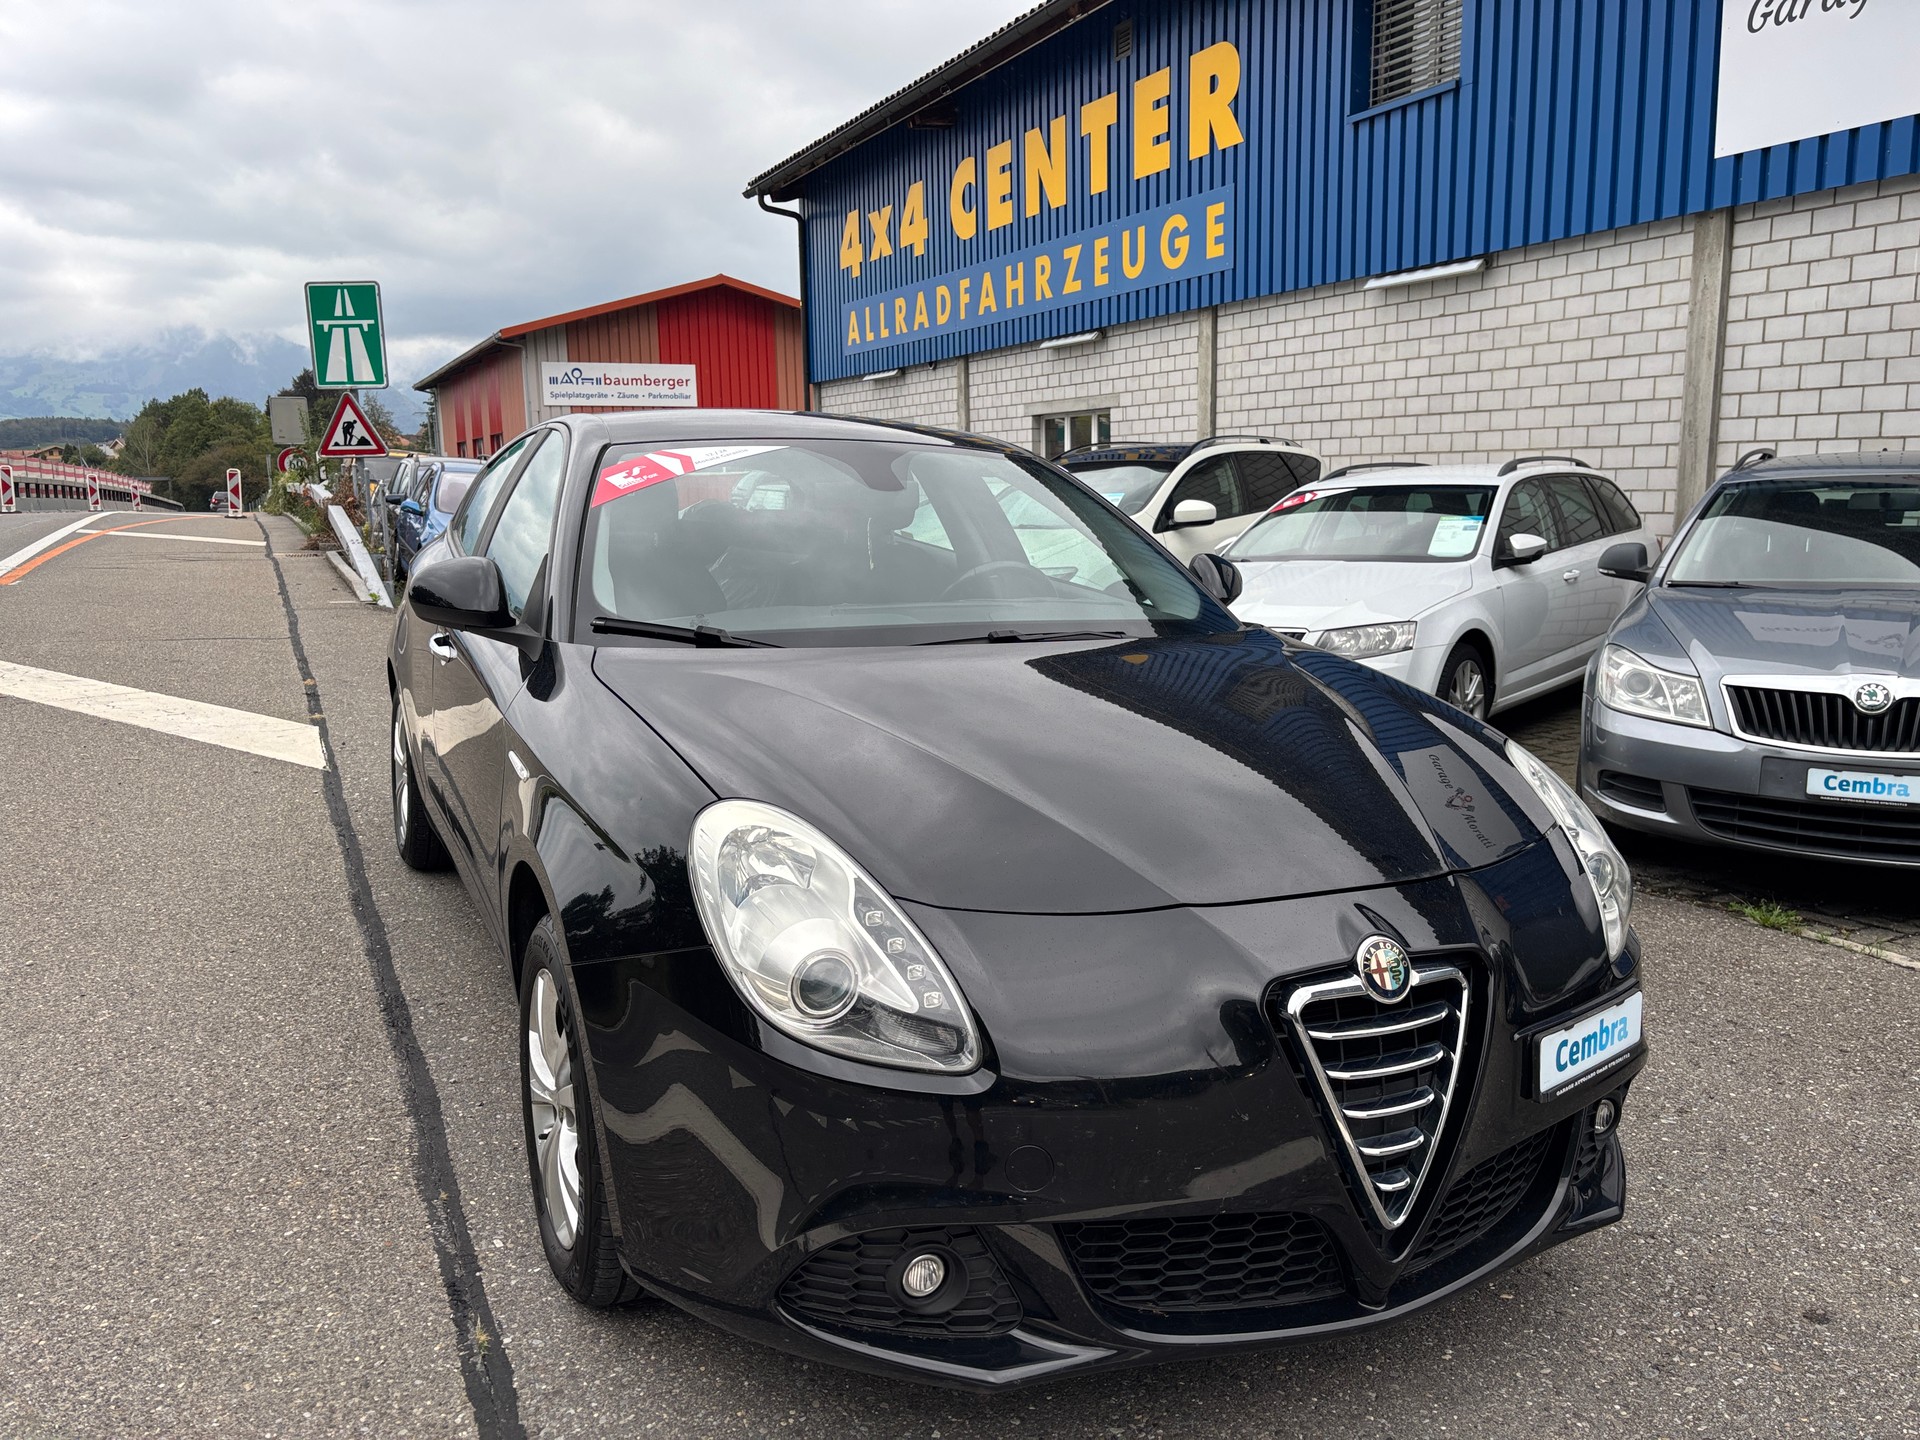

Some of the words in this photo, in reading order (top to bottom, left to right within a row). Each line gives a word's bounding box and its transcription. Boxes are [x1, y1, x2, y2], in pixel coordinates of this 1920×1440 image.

[839, 180, 928, 279] 4x4
[950, 41, 1244, 240] CENTER
[847, 201, 1225, 346] ALLRADFAHRZEUGE
[549, 391, 609, 400] Spielplatzgeräte
[616, 391, 639, 399] Zäune
[647, 392, 692, 400] Parkmobiliar
[603, 373, 691, 390] baumberger
[1428, 754, 1454, 789] Garage
[1461, 812, 1497, 849] Moratti
[1823, 774, 1911, 797] Cembra
[1363, 946, 1377, 974] ALFA
[1378, 942, 1408, 967] ROMEO
[1555, 1016, 1629, 1073] Cembra
